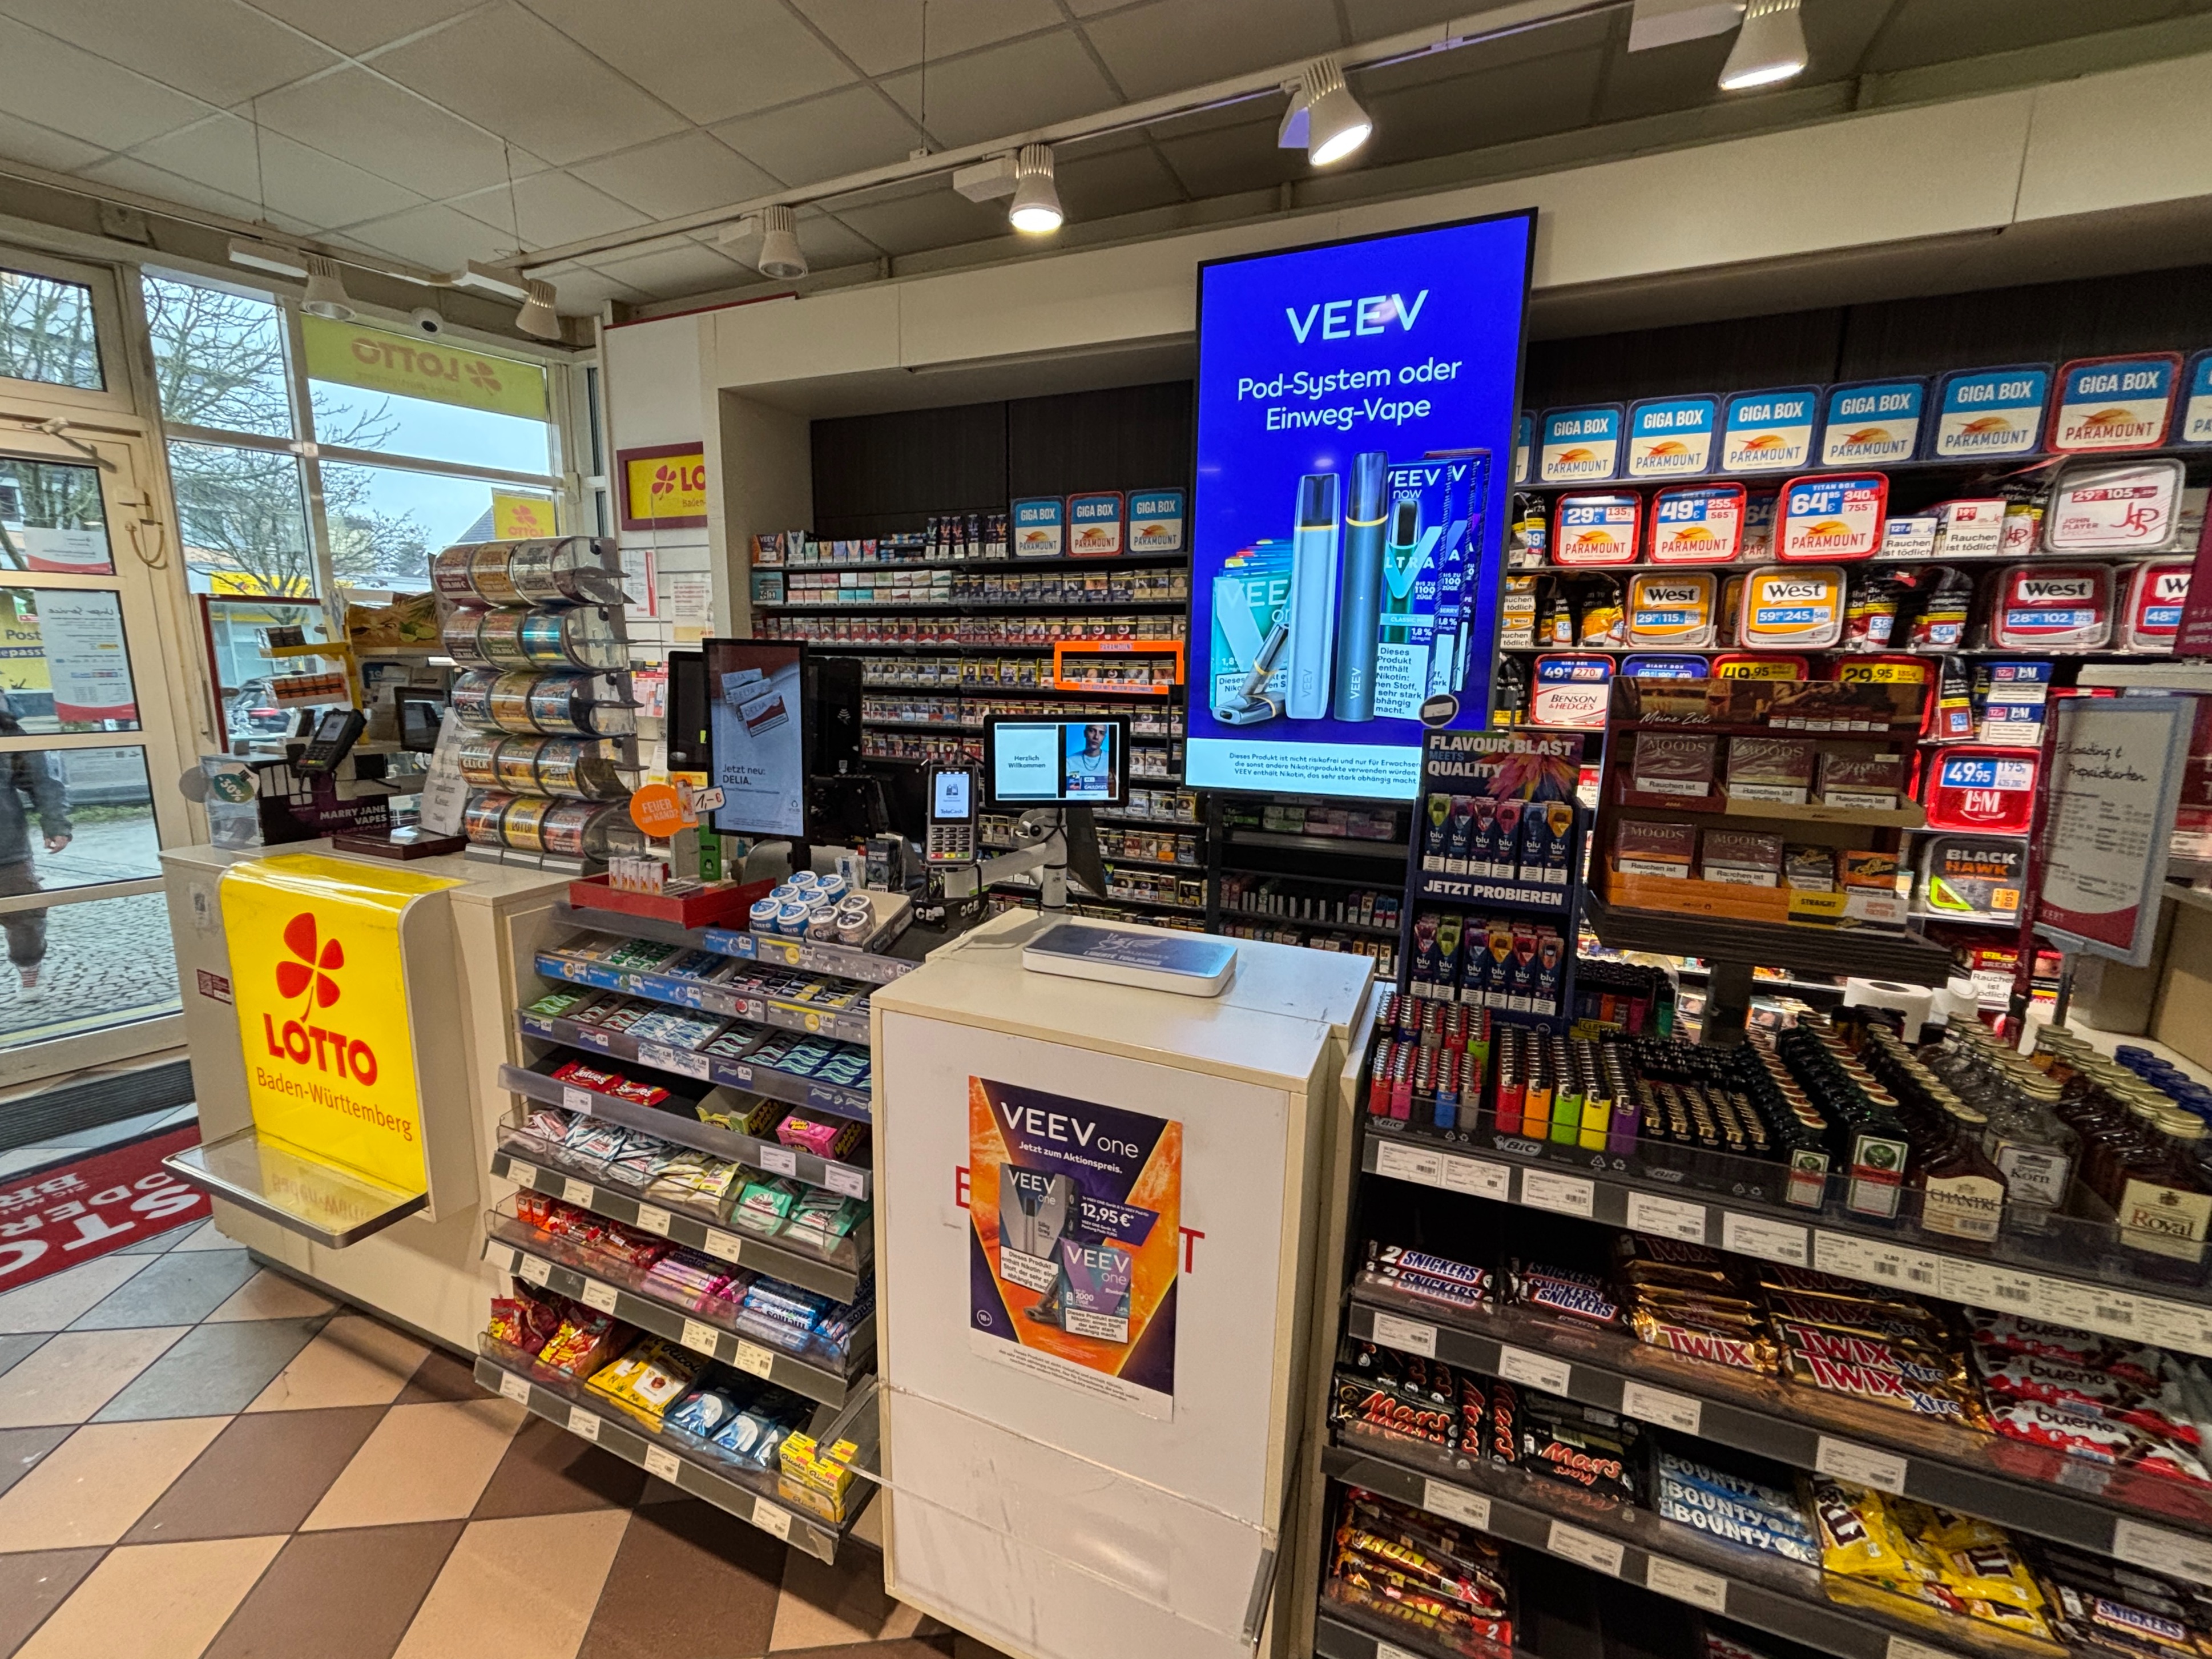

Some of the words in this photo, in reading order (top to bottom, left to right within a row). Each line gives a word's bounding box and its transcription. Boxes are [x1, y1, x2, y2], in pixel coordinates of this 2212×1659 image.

[1285, 289, 1429, 344] VEEV
[1238, 368, 1391, 401] Pod-System
[1398, 357, 1462, 385] oder
[2079, 374, 2118, 394] GIGA
[2122, 371, 2161, 390] BOX
[1957, 385, 1995, 404] GIGA
[1997, 381, 2035, 400] BOX
[1739, 404, 1770, 422] GIGA
[1774, 401, 1803, 418] BOX
[1841, 396, 1875, 416] GIGA
[1878, 393, 1912, 411] BOX
[1266, 398, 1432, 432] Einweg-Vape
[1644, 412, 1673, 429] GIGA
[1676, 409, 1703, 426] BOX
[1554, 420, 1581, 437] GIGA
[1584, 418, 1609, 434] BOX
[1635, 452, 1702, 469] PARAMOUNT
[1730, 446, 1802, 464] PARAMOUNT
[1547, 459, 1608, 474] PARAMOUNT
[1393, 488, 1422, 500] now
[1661, 500, 1694, 520] 49
[1661, 538, 1728, 553] PARAMOUNT
[1791, 533, 1867, 549] PARAMOUNT
[1886, 539, 1931, 548] Rauchen
[1946, 543, 1960, 551] ist
[1961, 542, 1997, 551] tödlich
[1951, 533, 1997, 542] Rauchen
[1565, 542, 1626, 554] PARAMOUNT
[1647, 586, 1695, 602] West
[1768, 582, 1822, 600] West
[2024, 582, 2086, 597] West
[1377, 656, 1412, 665] Produkt
[1380, 647, 1409, 657] Dieses
[1379, 665, 1409, 673] enthält
[1350, 667, 1361, 699] VEEV
[1396, 691, 1422, 700] stark
[1550, 694, 1598, 703] BENSON
[1555, 702, 1594, 711] HEDGES
[1639, 711, 1679, 724] Meine
[1682, 711, 1711, 725] Zeit
[1429, 735, 1509, 754] FLAVOUR
[1513, 740, 1575, 756] BLAST
[1646, 739, 1707, 753] MOODS
[1428, 751, 1465, 762] MEETS
[722, 764, 746, 774] Jetzt
[747, 766, 765, 775] neu:
[1427, 760, 1504, 779] QUALITY
[722, 775, 752, 786] DELIA.
[1649, 780, 1680, 790] Rauchen
[1964, 789, 2001, 814] L&M
[320, 808, 359, 821] MARRY
[360, 804, 386, 816] JANE
[354, 814, 388, 826] VAPES
[1631, 827, 1686, 840] MOODS
[1946, 849, 2017, 864] BLACK
[1631, 862, 1662, 872] Rauchen
[1423, 880, 1471, 897] JETZT
[1473, 885, 1563, 906] PROBIEREN
[263, 1012, 378, 1086] LOTTO
[256, 1066, 413, 1142] Baden-Württemberg
[1000, 1101, 1095, 1147] VEEV
[1097, 1137, 1139, 1158] one
[1018, 1141, 1042, 1155] Jetzt
[1043, 1149, 1061, 1159] zum
[1063, 1152, 1123, 1174] Aktionspreis.
[1008, 1169, 1056, 1194] VEEV
[2010, 1166, 2050, 1186] Korn
[1038, 1194, 1056, 1205] one
[1080, 1202, 1118, 1224] 12,95
[2129, 1210, 2194, 1240] Royal
[1066, 1245, 1130, 1274] VEEV
[1380, 1245, 1403, 1264] 2
[1402, 1250, 1481, 1284] SNICKERS
[1101, 1273, 1127, 1285] one
[1538, 1288, 1615, 1318] SNICKERS
[2016, 1315, 2091, 1342] bueno
[1657, 1324, 1754, 1368] TWIX
[1785, 1323, 1896, 1368] TWIX
[1893, 1360, 1945, 1383] Xtra
[1794, 1348, 1908, 1398] TWIX
[1905, 1389, 1961, 1415] Xtra
[2028, 1360, 2106, 1386] bueno
[1359, 1391, 1451, 1430] Mars
[2036, 1406, 2116, 1433] bueno
[781, 1453, 806, 1472] Ricola
[1541, 1442, 1622, 1479] Mars
[809, 1469, 835, 1488] Ricola
[1662, 1454, 1755, 1495] BOUNTY
[1667, 1481, 1764, 1528] BOUNTY
[1674, 1503, 1771, 1550] BOUNTY
[2096, 1599, 2183, 1640] SNICKERS
